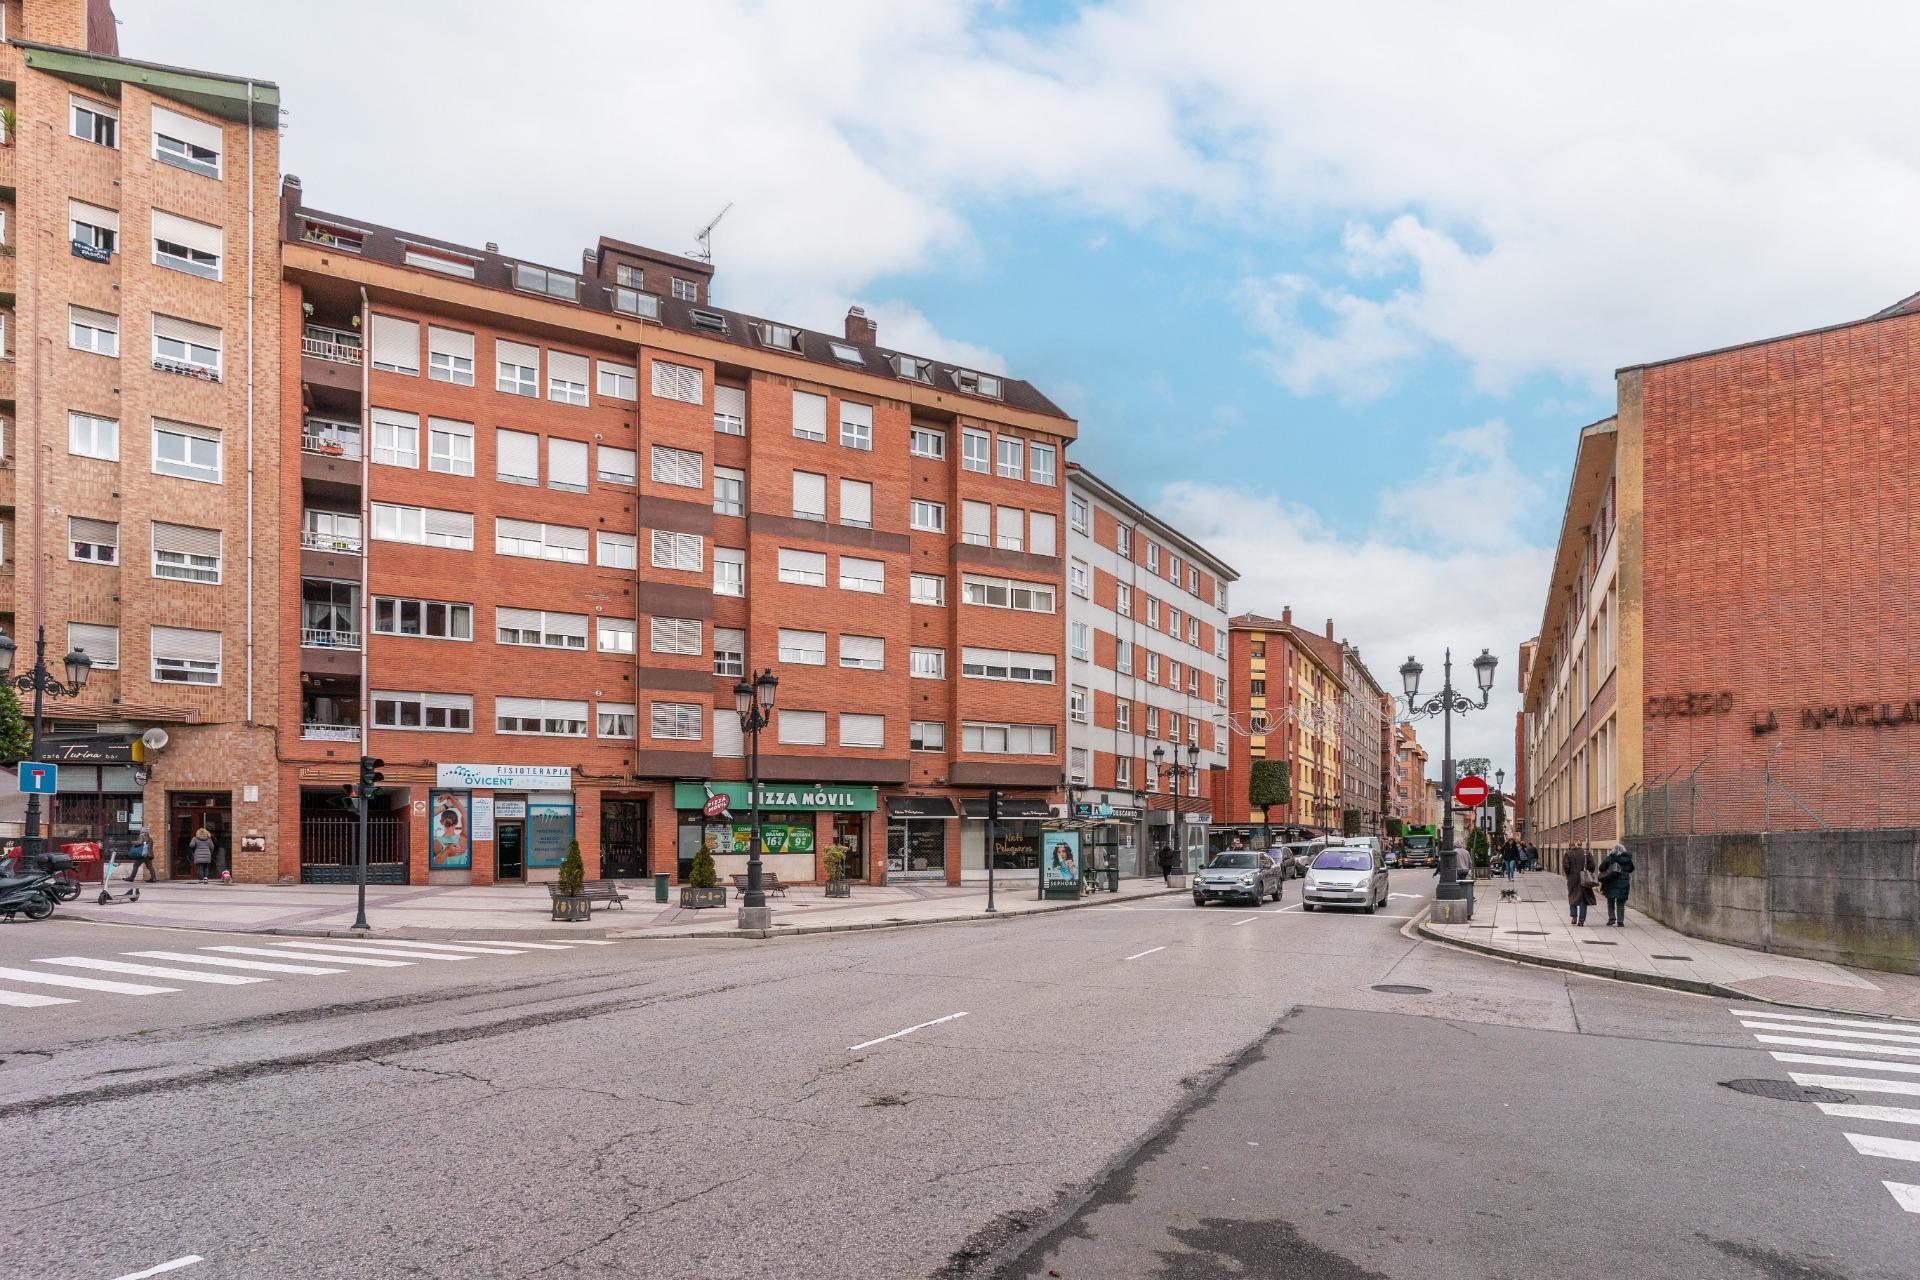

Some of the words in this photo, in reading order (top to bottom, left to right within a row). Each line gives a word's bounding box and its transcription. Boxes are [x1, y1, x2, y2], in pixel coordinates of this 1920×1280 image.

[1752, 711, 1778, 733] LA
[1802, 702, 1920, 728] INMACULA
[60, 744, 102, 759] Turina
[497, 767, 569, 775] FISIOTERAPIA
[465, 777, 514, 785] OVICENT
[802, 789, 854, 805] MÓVIL
